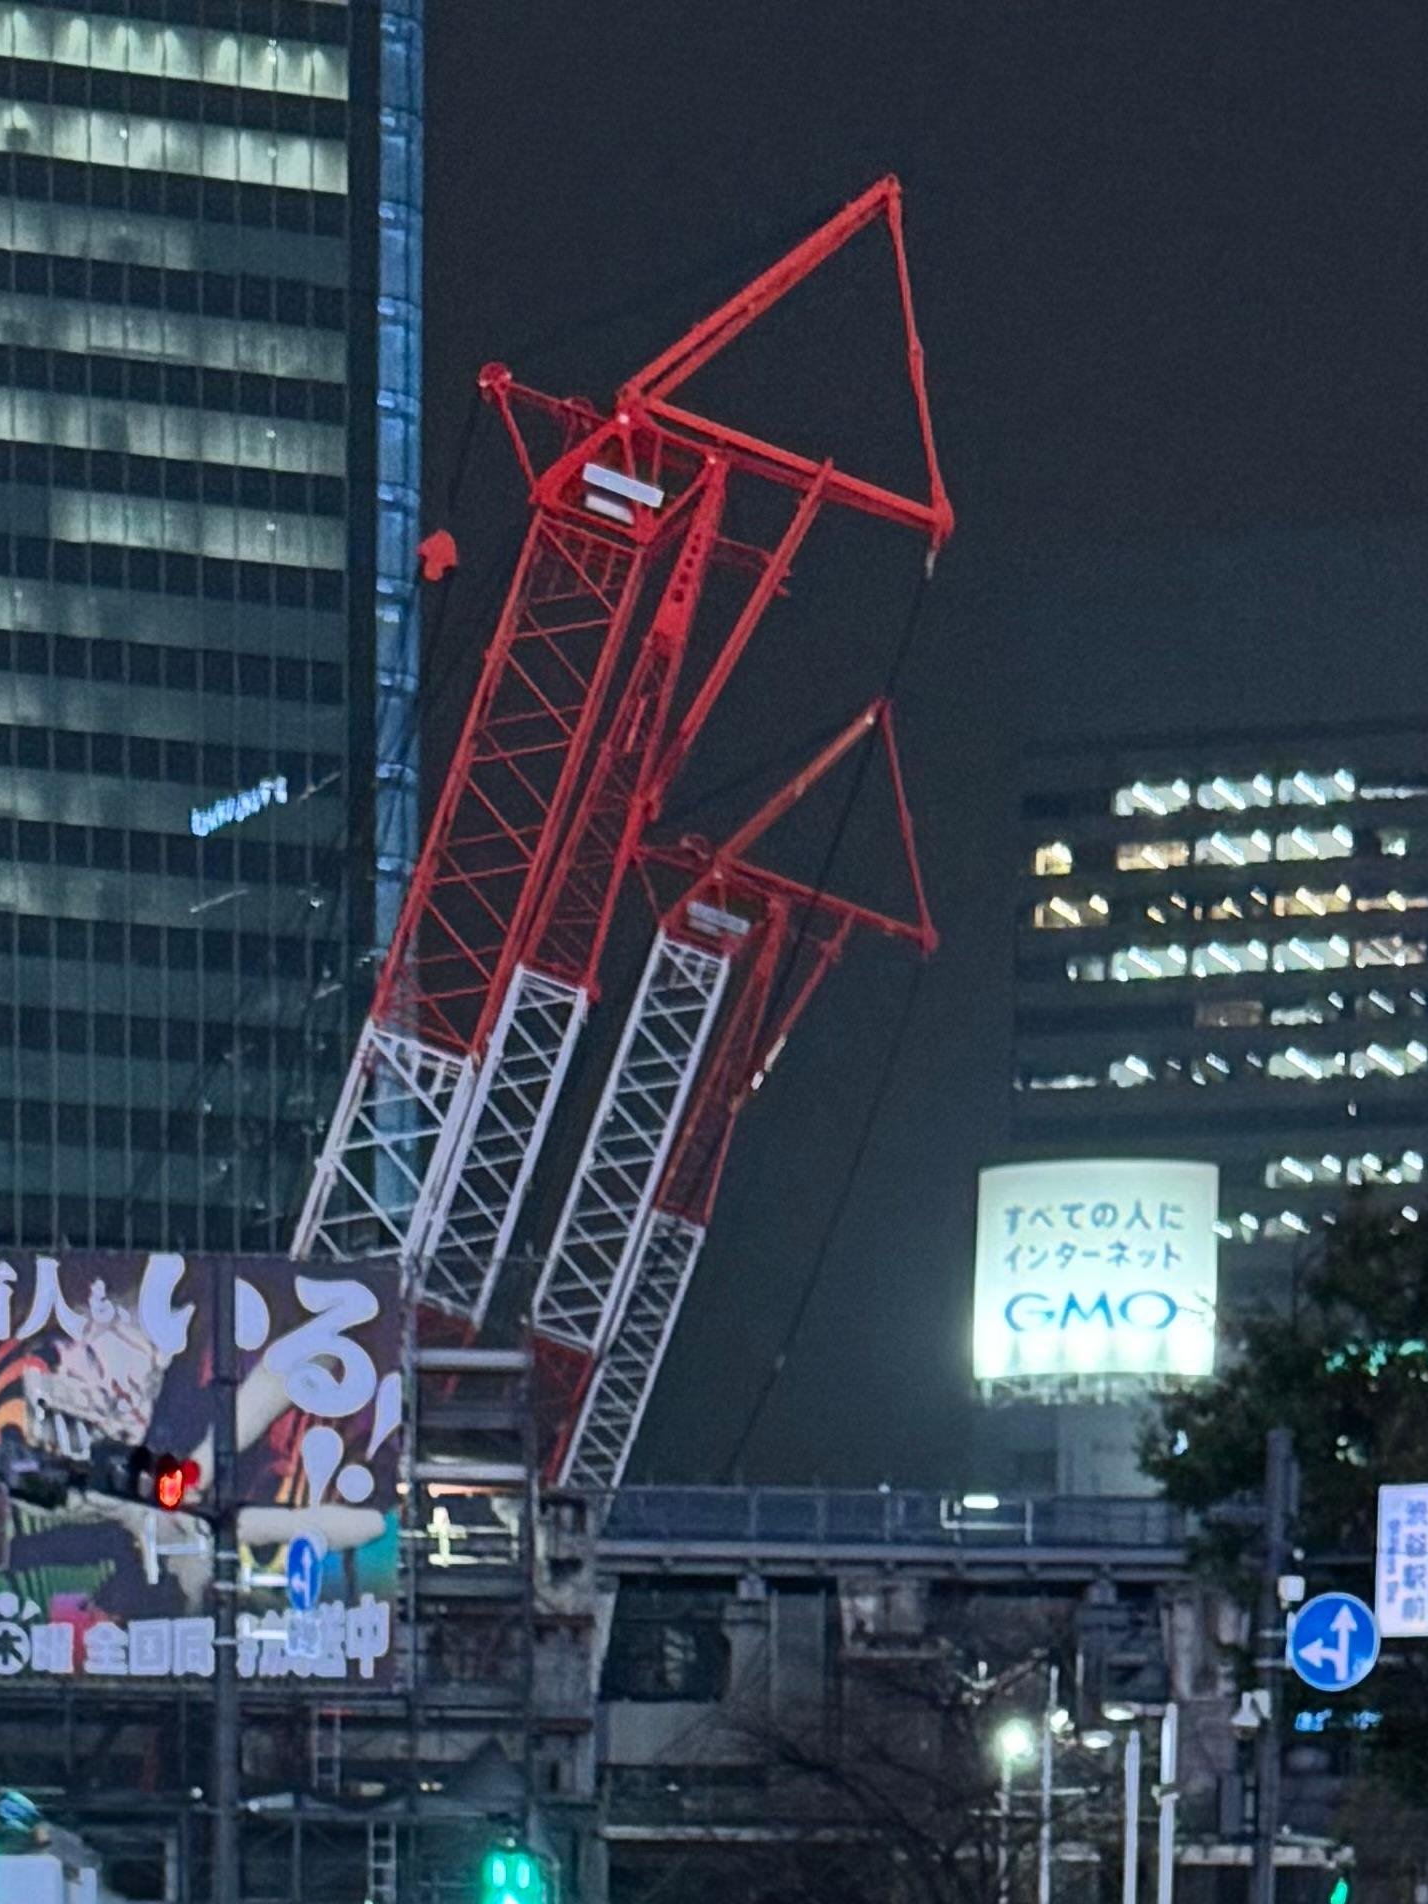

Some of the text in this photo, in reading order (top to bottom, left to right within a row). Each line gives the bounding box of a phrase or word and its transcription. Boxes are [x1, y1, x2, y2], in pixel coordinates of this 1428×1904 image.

[1005, 1199, 1185, 1235] すべての人に
[1005, 1241, 1181, 1272] インターネット
[1005, 1291, 1178, 1332] GMO
